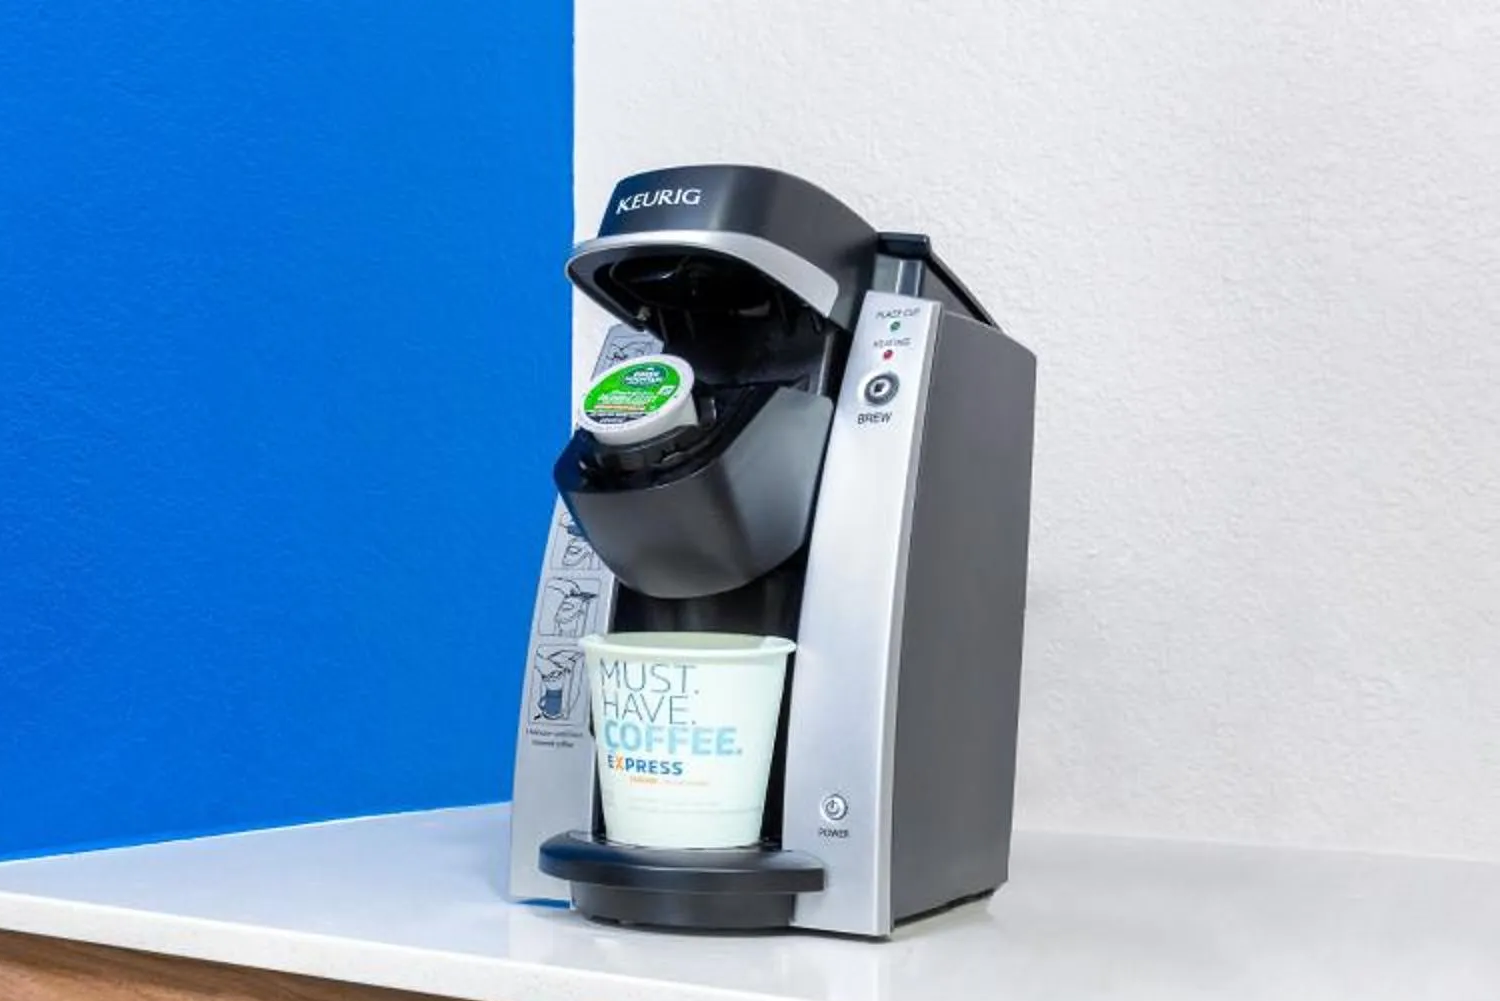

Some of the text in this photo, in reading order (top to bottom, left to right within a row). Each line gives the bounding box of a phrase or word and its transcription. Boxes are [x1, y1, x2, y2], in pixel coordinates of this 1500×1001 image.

[615, 187, 702, 215] KEURIG
[857, 412, 892, 425] BREW
[599, 657, 700, 695] MUST.
[601, 690, 697, 725] HAVE.
[604, 719, 743, 756] COFFEE.
[606, 754, 684, 776] EXPRESS
[818, 827, 849, 839] POWER
